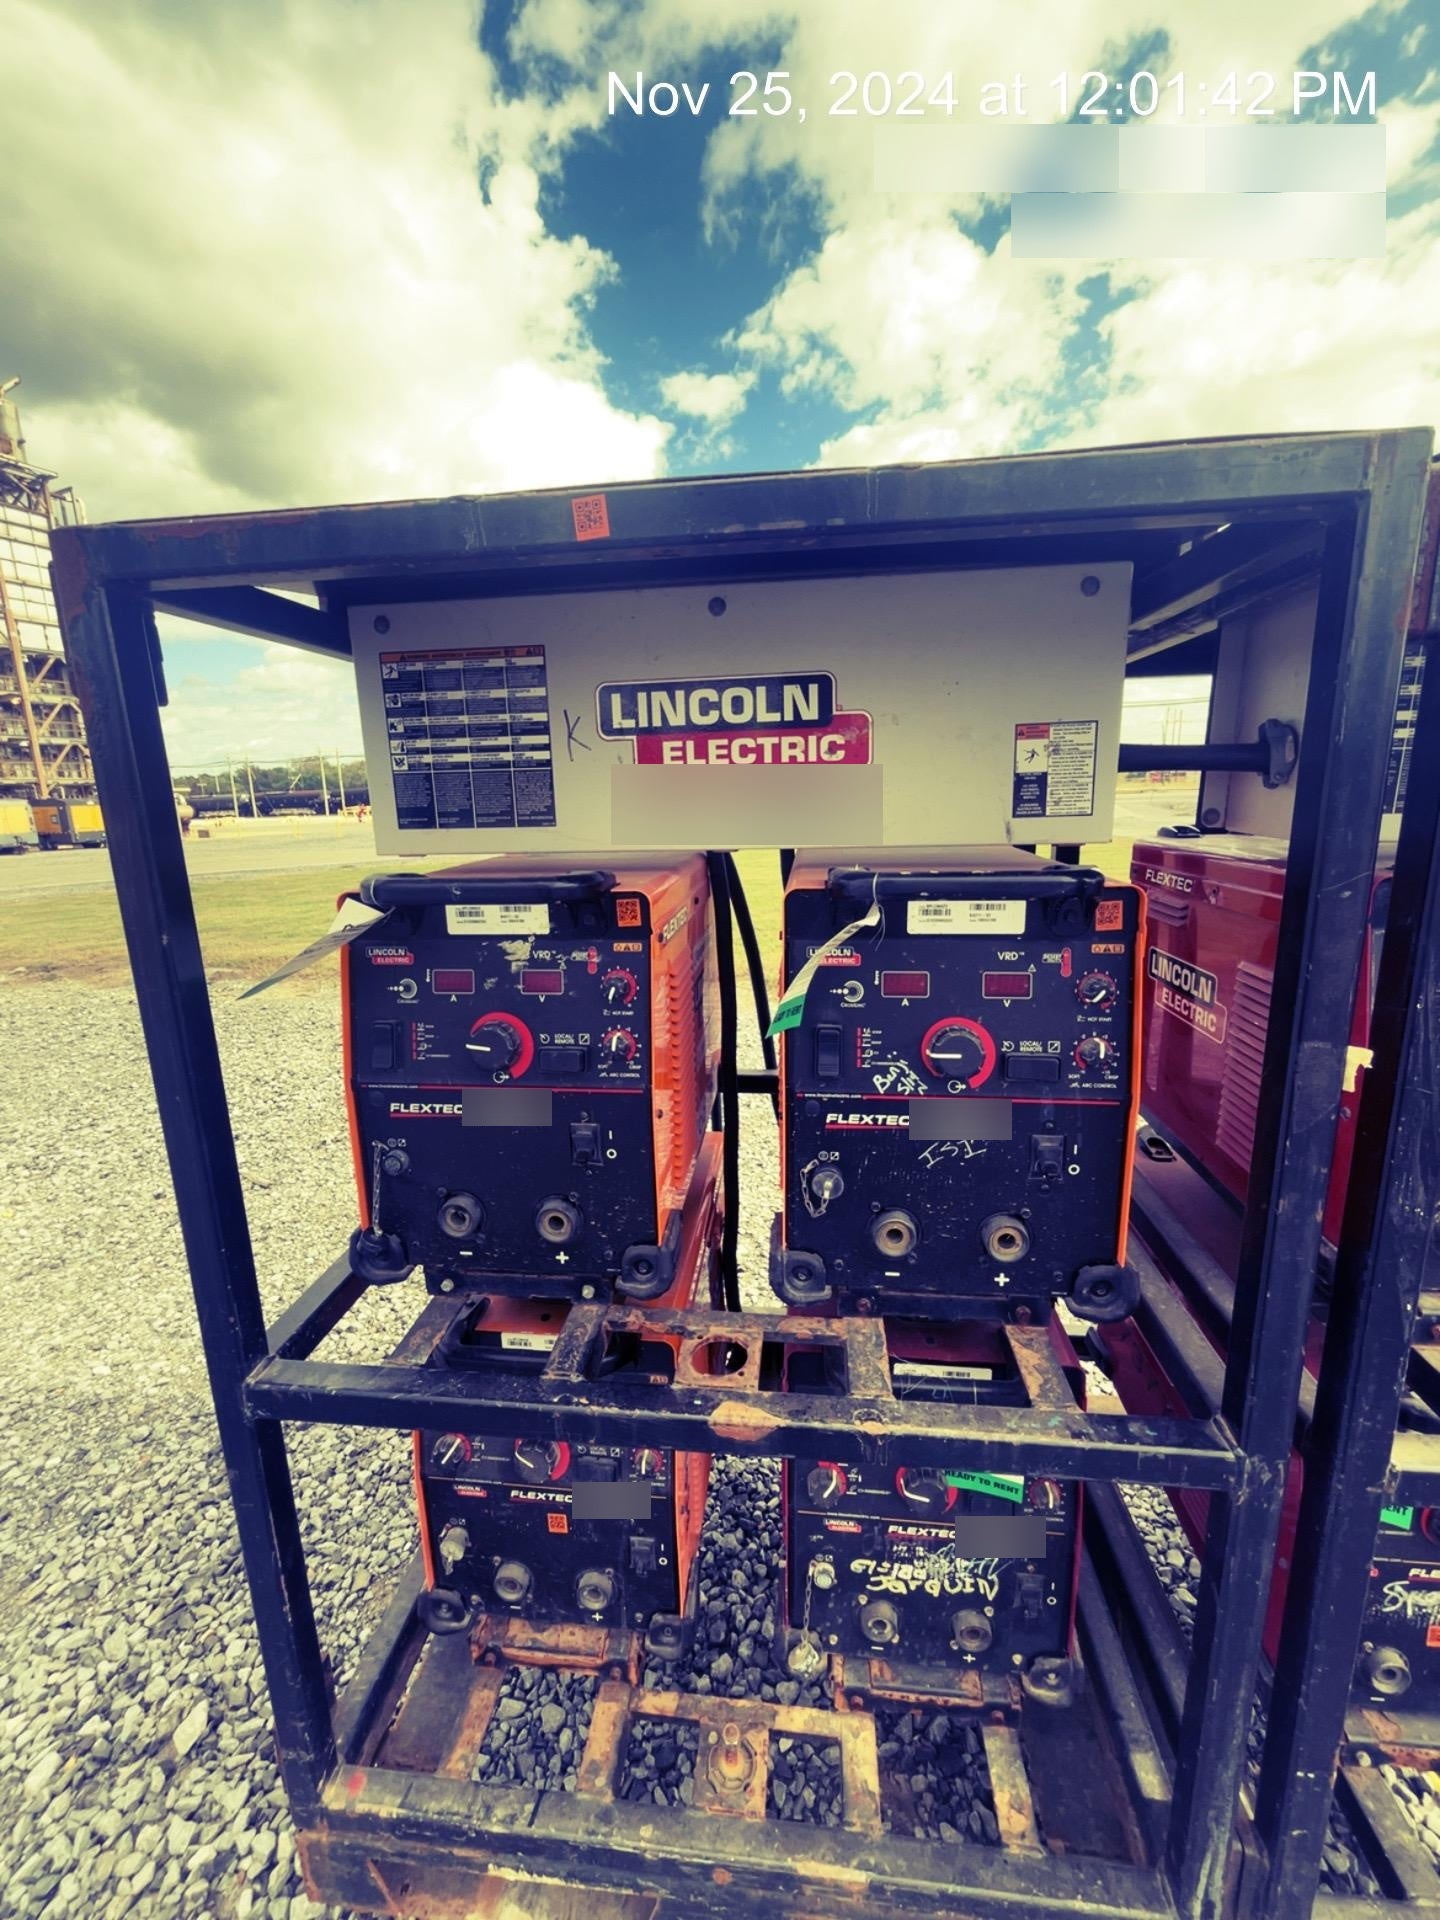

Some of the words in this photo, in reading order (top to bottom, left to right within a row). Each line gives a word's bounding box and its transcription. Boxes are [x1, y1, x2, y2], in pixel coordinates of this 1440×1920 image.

[611, 684, 819, 729] LINCOLN
[662, 734, 846, 764] ELECTRIC
[1145, 869, 1194, 893] FLEXTEC
[368, 948, 406, 957] LINCOLN
[1151, 953, 1213, 1003] LINCOLN
[901, 998, 910, 1007] A
[1003, 999, 1011, 1008] V
[1162, 987, 1218, 1032] ELECTRIC
[390, 1102, 463, 1114] FLEXTEC
[826, 1113, 910, 1126] FLEXTEC
[978, 1477, 991, 1486] TO
[994, 1482, 1019, 1494] RENT
[510, 1490, 573, 1503] FLEXTEC
[888, 1525, 956, 1539] FLEXTEC
